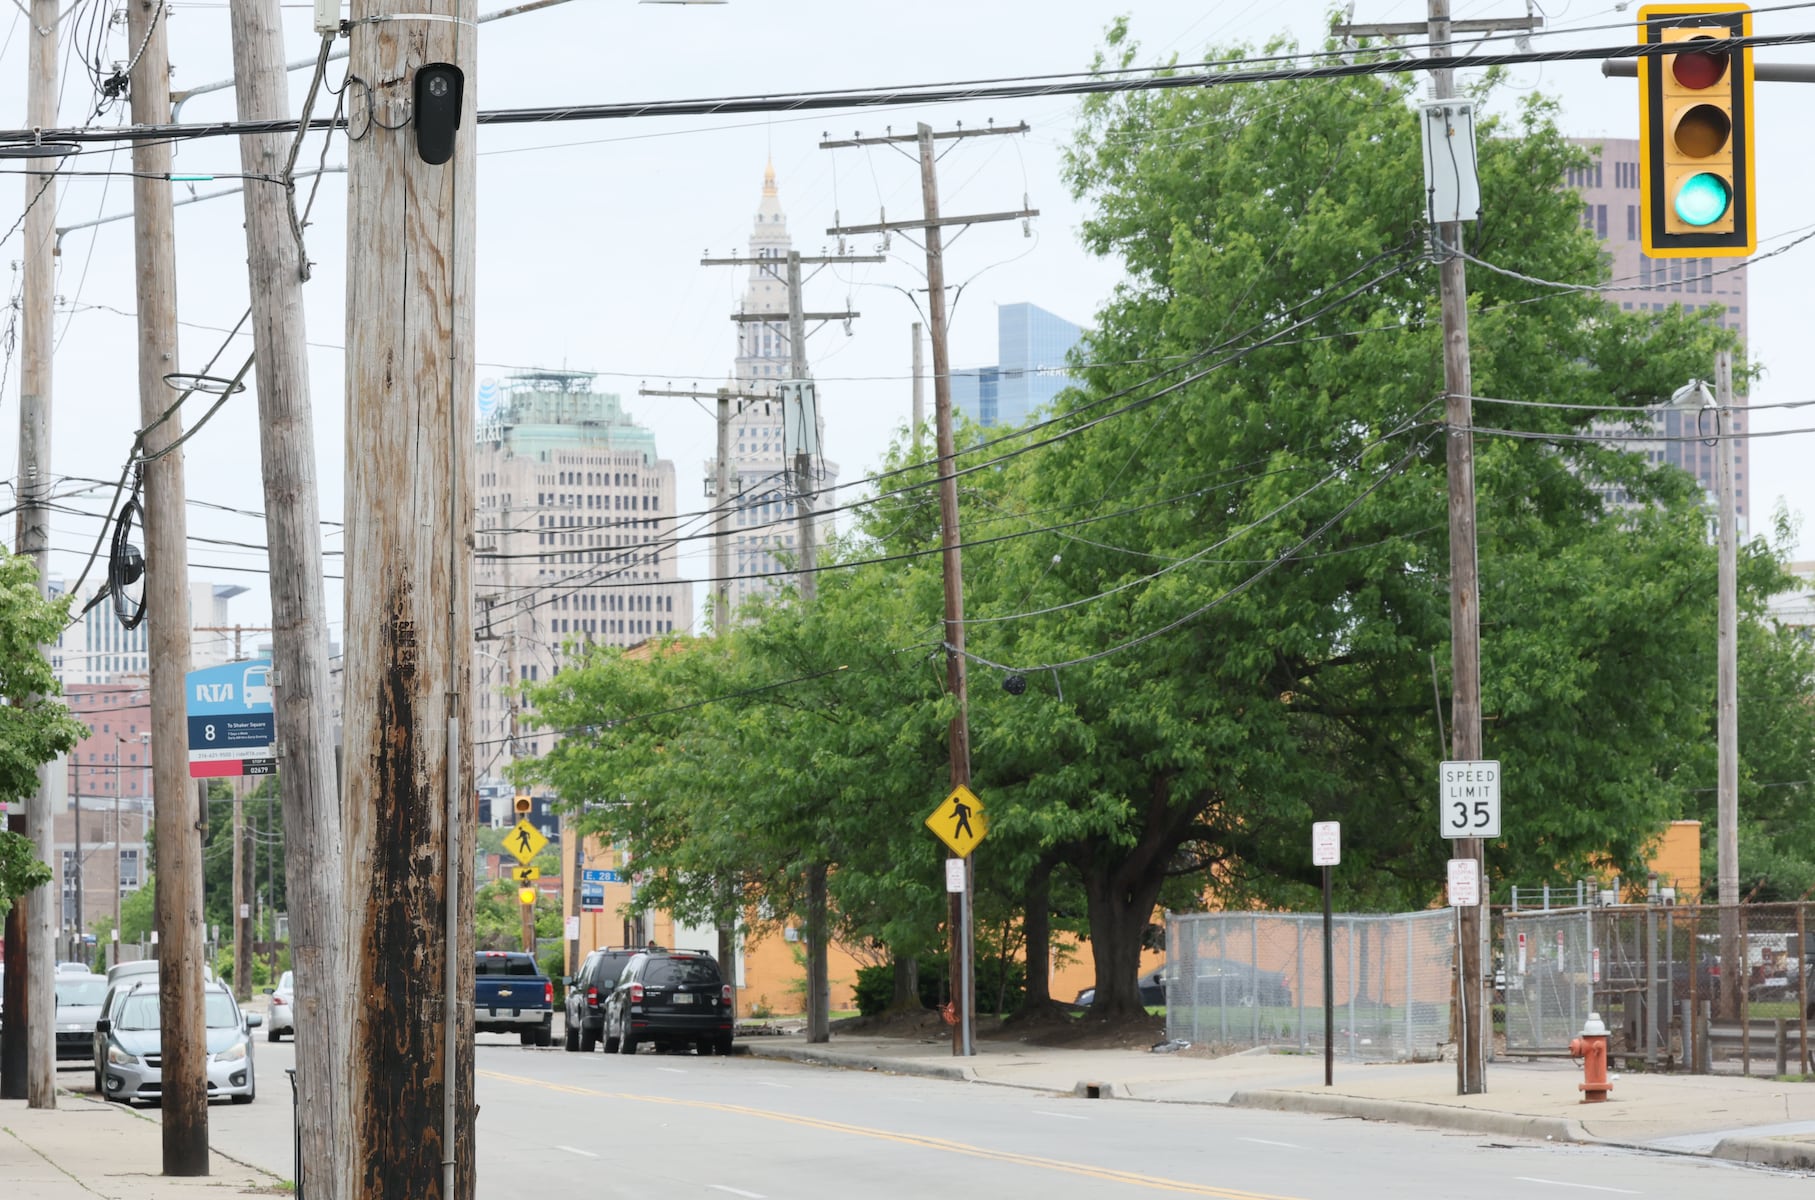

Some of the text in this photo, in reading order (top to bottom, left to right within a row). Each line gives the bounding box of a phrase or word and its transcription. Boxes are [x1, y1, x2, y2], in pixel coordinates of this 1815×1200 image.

[196, 683, 234, 703] RTA
[205, 724, 216, 741] 8
[1447, 771, 1495, 782] SPEED
[1451, 786, 1490, 797] LIMIT
[1452, 802, 1490, 828] 35
[586, 871, 596, 880] E.
[600, 872, 611, 881] 28
